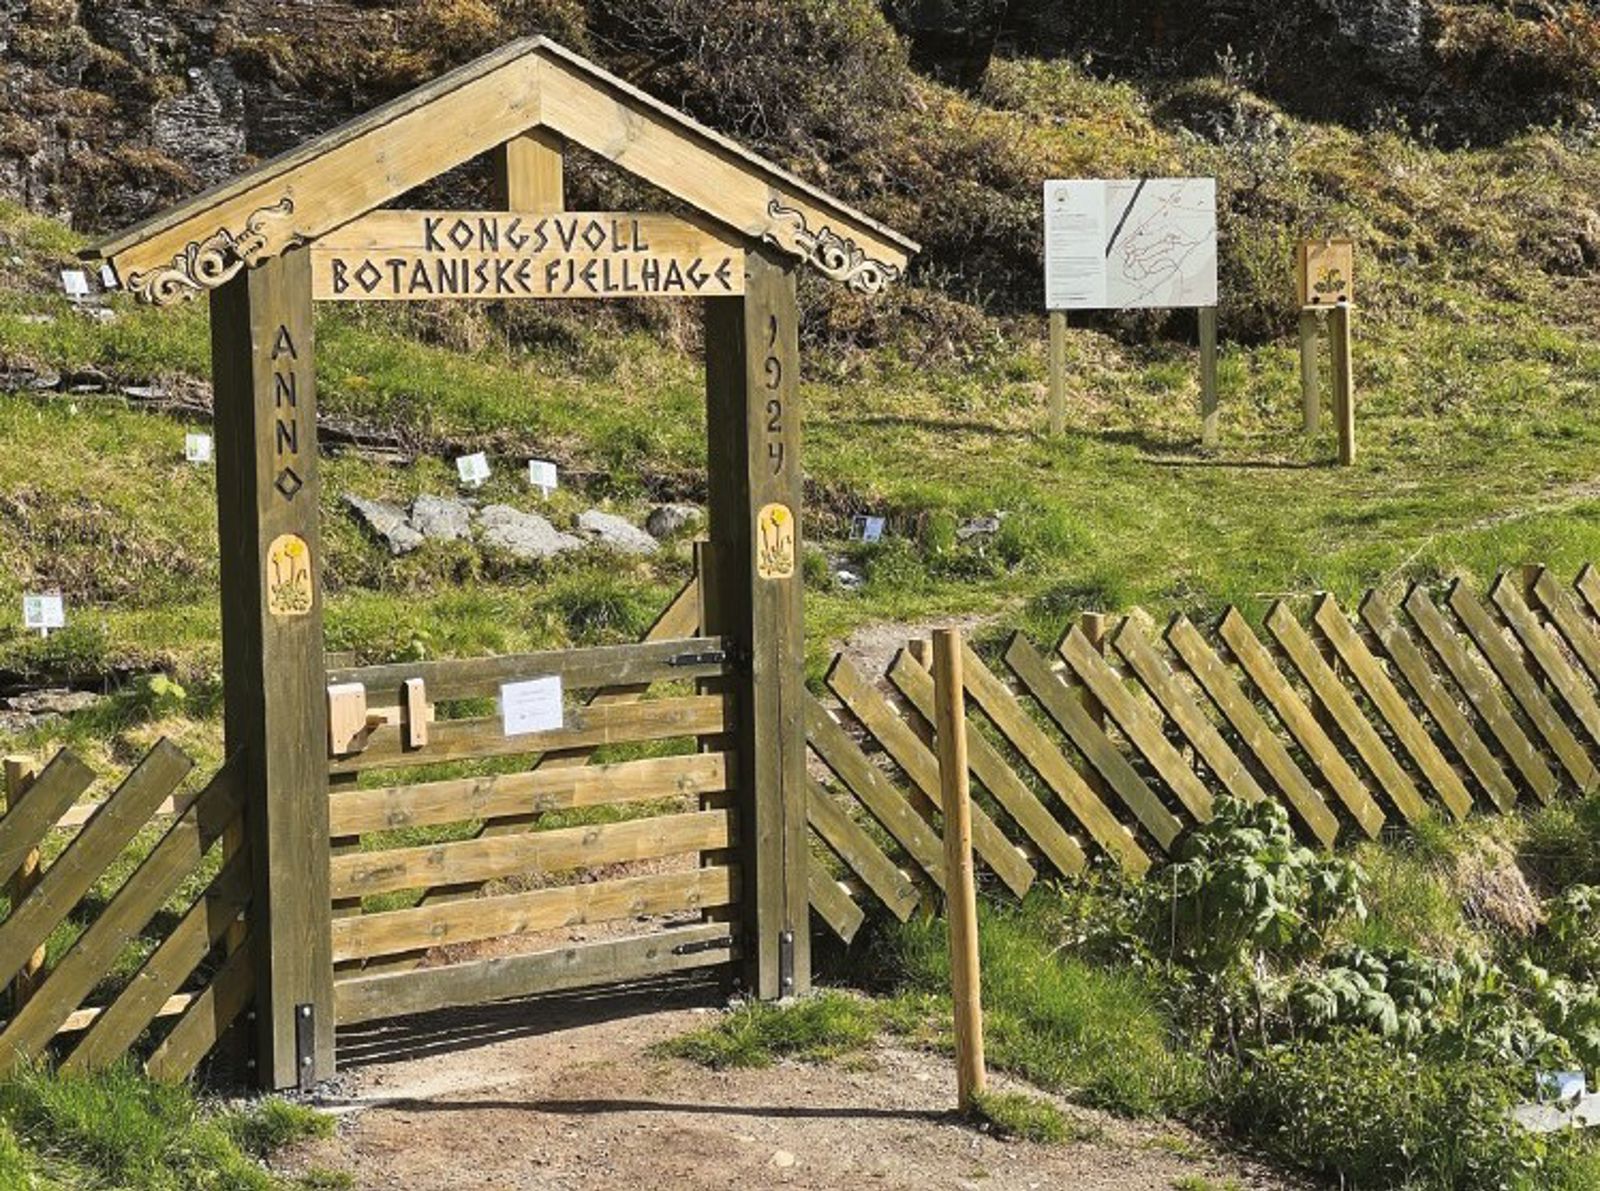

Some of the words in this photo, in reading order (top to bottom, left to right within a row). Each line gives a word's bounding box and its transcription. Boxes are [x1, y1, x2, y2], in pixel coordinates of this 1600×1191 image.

[332, 258, 532, 294] BOTANISKE
[545, 257, 732, 293] FJELLHAGE
[424, 217, 649, 252] KONGSVOLL
[271, 324, 303, 501] ANNO
[764, 314, 784, 476] 1924
